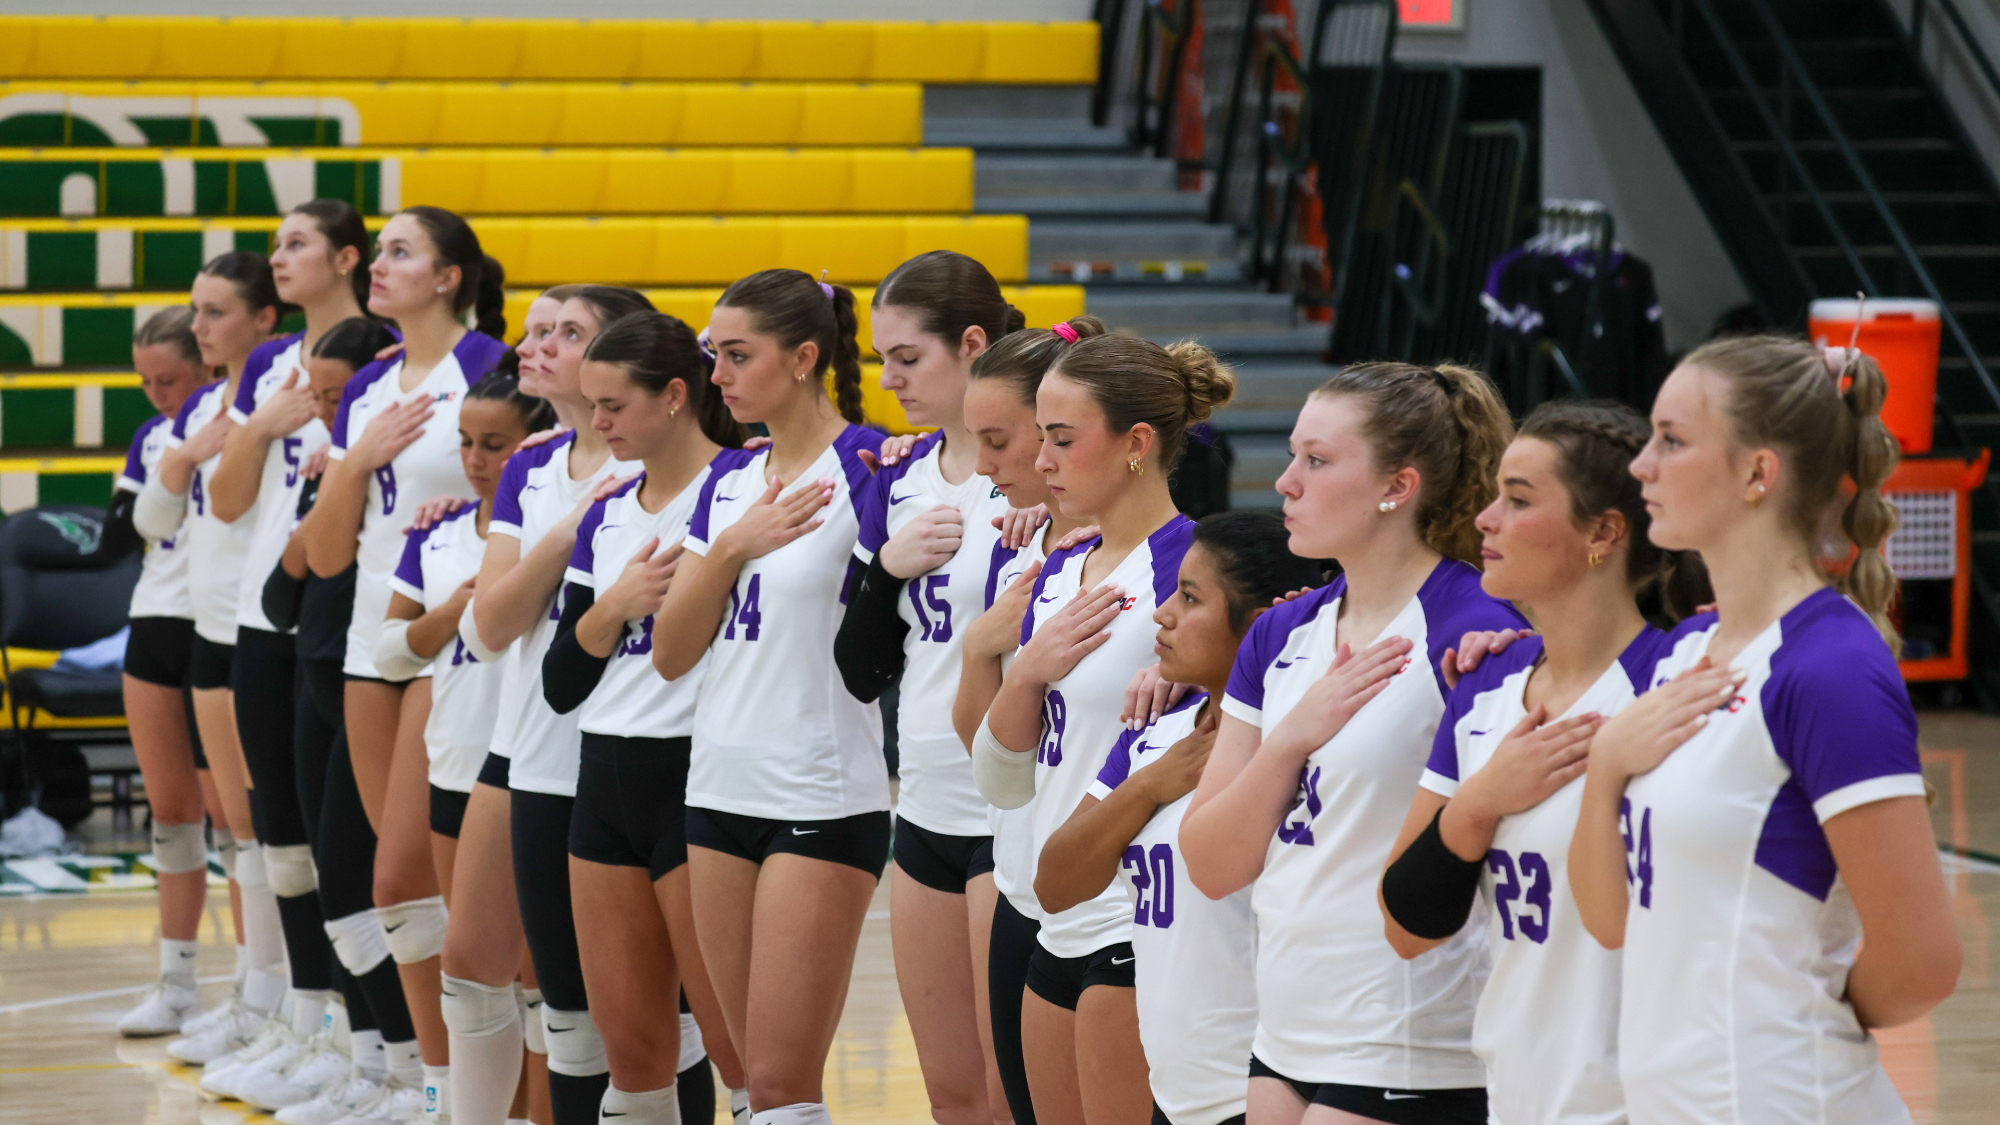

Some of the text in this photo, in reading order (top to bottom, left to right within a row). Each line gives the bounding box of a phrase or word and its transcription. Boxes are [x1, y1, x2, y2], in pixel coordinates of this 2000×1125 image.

[192, 469, 204, 516] 4
[284, 438, 302, 488] 5
[376, 463, 397, 515] 8
[724, 573, 761, 641] 14
[908, 573, 953, 643] 15
[1037, 689, 1067, 767] 19
[1121, 843, 1174, 929] 20
[1486, 849, 1552, 945] 23
